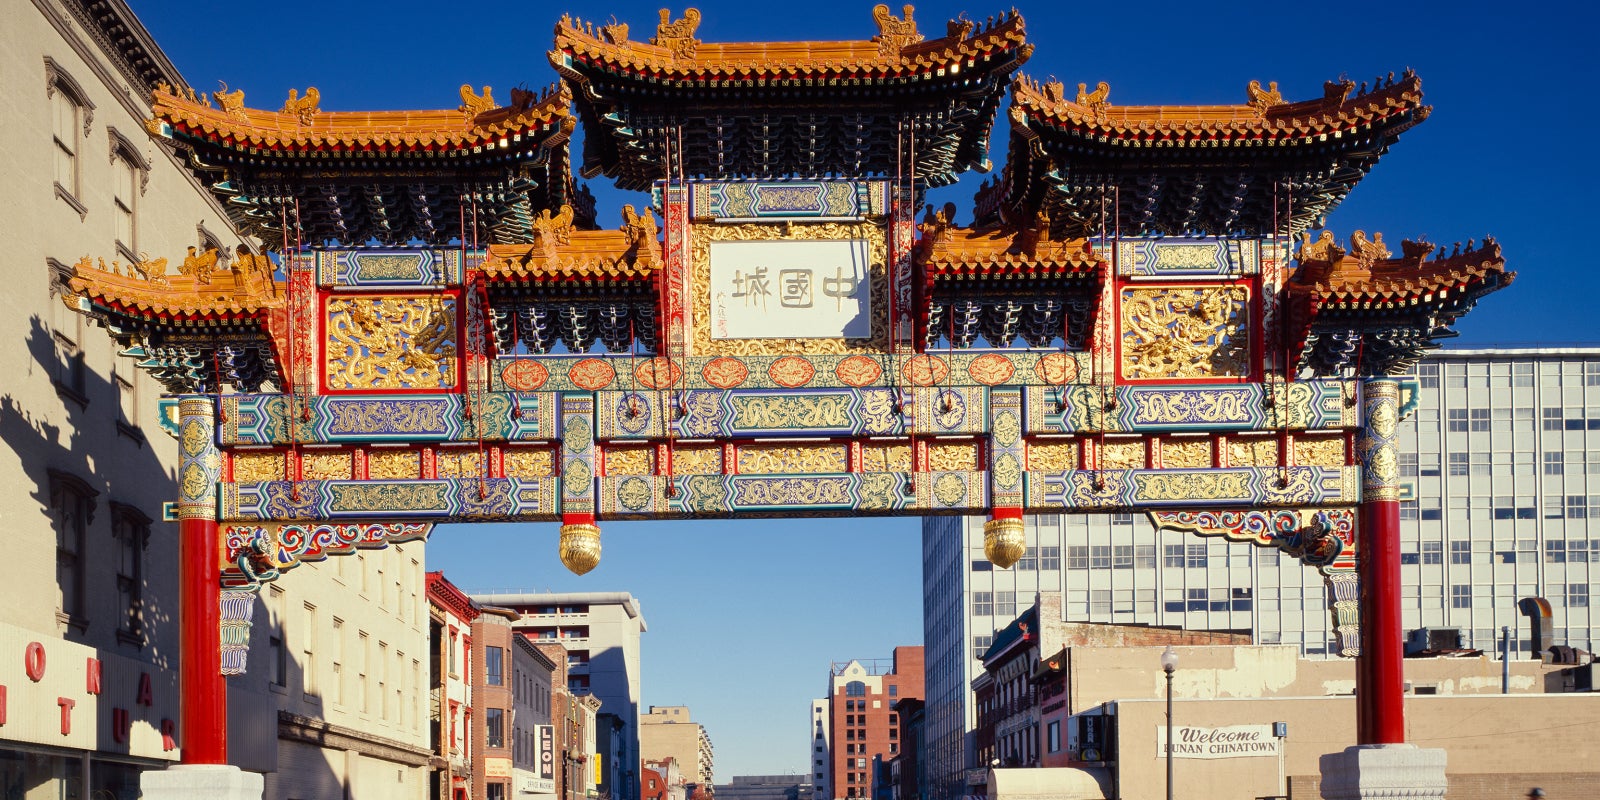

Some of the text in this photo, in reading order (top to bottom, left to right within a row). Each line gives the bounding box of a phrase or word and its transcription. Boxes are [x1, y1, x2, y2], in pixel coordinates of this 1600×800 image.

[1179, 728, 1260, 743] Welcome
[541, 728, 552, 774] LEON
[1209, 742, 1276, 754] CHINATOWN
